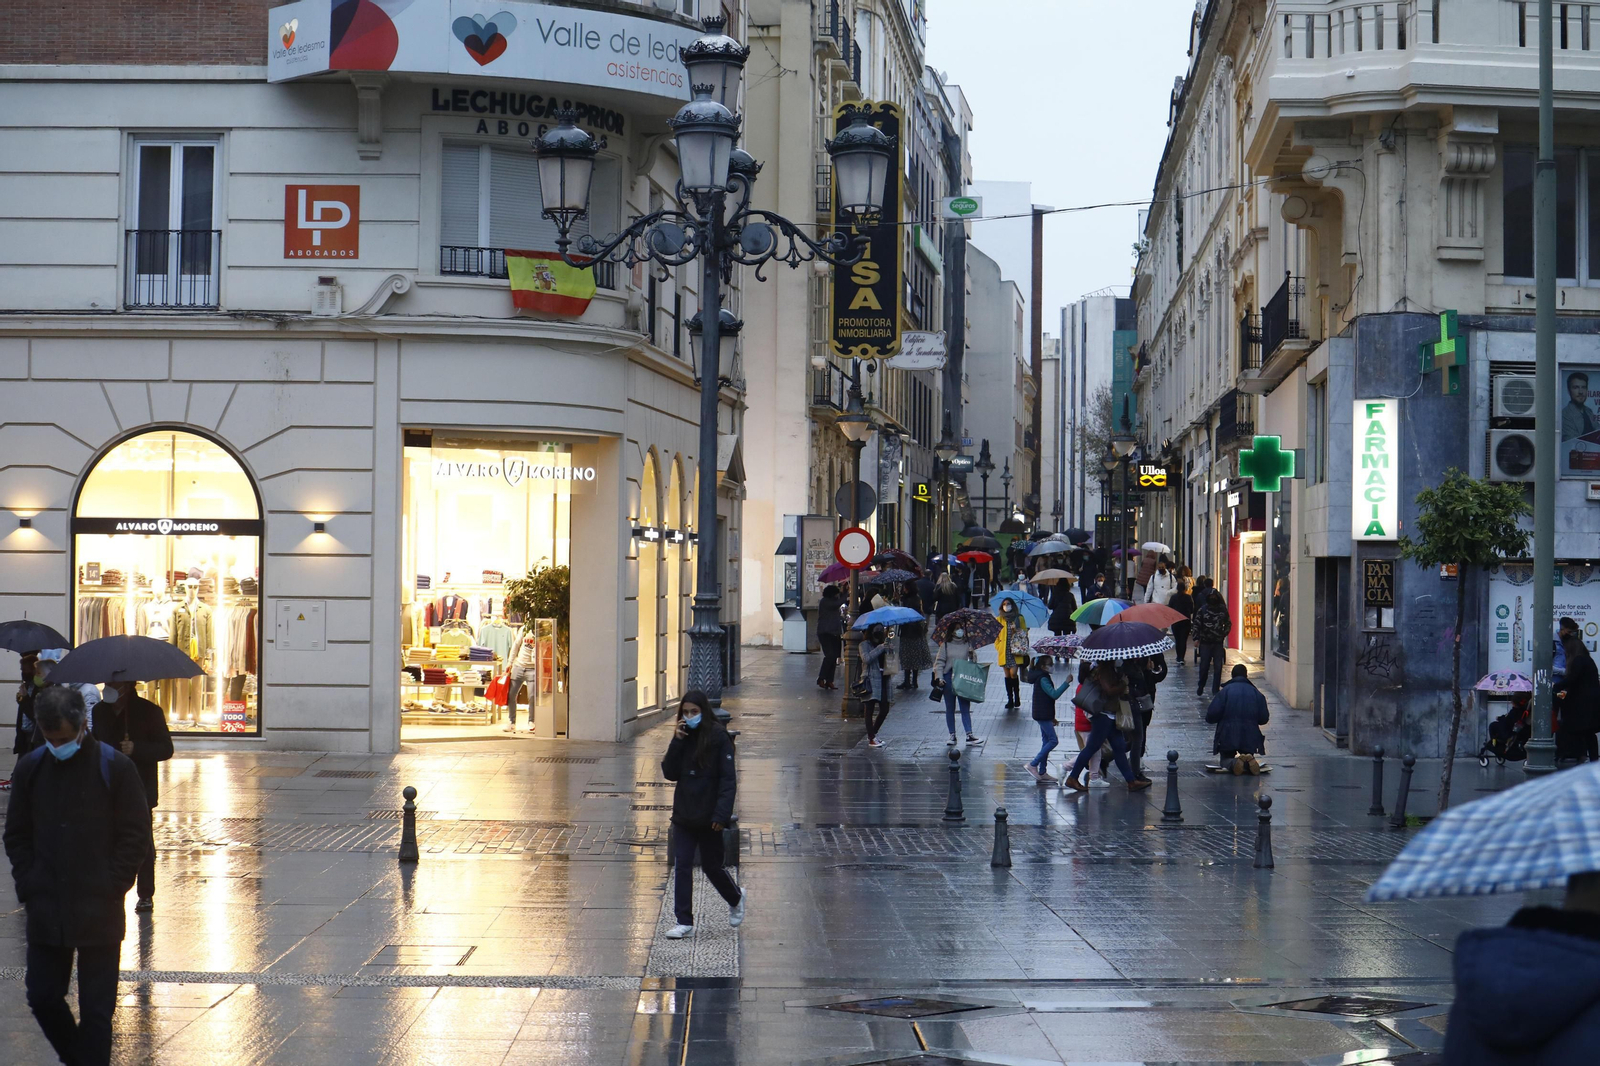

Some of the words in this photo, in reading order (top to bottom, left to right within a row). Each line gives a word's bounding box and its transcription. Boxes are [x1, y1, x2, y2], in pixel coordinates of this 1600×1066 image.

[536, 18, 600, 50] Valle
[610, 28, 641, 56] de
[272, 48, 287, 60] Valle
[288, 45, 297, 56] de
[297, 40, 325, 55] ledesma
[606, 62, 683, 88] asistencias
[838, 318, 892, 327] PROMOTORA
[838, 328, 892, 338] INMOBILIARIA
[436, 461, 500, 478] ALVARO
[527, 465, 596, 482] MORENO
[1140, 465, 1167, 475] Ulloa
[1361, 402, 1390, 537] FARMACIA
[116, 522, 157, 531] ALVARO
[173, 523, 219, 531] MORENO
[1367, 564, 1391, 576] FAR
[1368, 576, 1389, 588] MA
[1367, 588, 1392, 601] CIA
